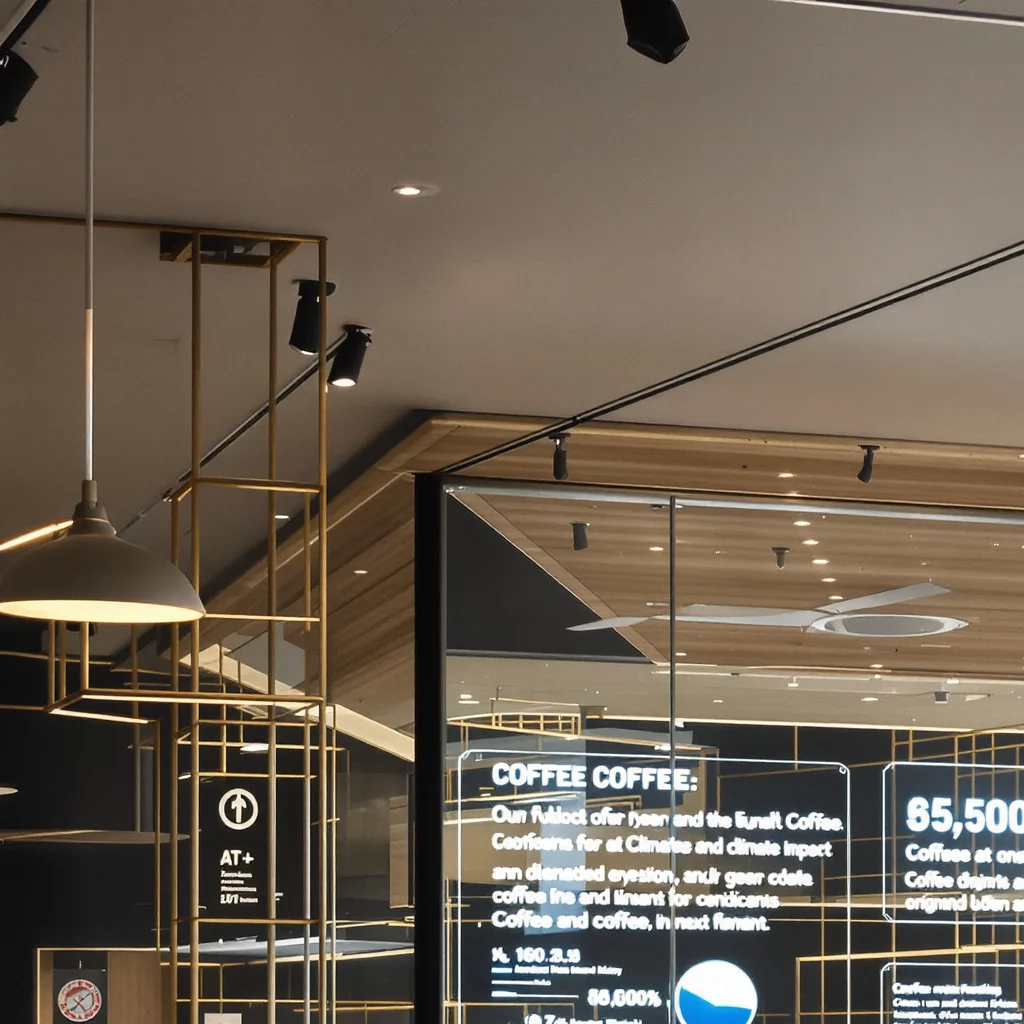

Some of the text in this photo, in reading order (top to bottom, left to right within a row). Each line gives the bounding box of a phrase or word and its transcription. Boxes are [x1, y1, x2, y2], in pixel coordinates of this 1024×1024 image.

[492, 762, 698, 792] COFFEE COFFEE:
[673, 810, 704, 828] and
[706, 811, 733, 829] the
[695, 836, 724, 855] and
[220, 849, 254, 866] AT+
[904, 870, 954, 888] Coffee
[492, 885, 547, 904] coffee
[578, 888, 611, 905] and
[491, 909, 553, 929] Coffee
[557, 911, 589, 929] and
